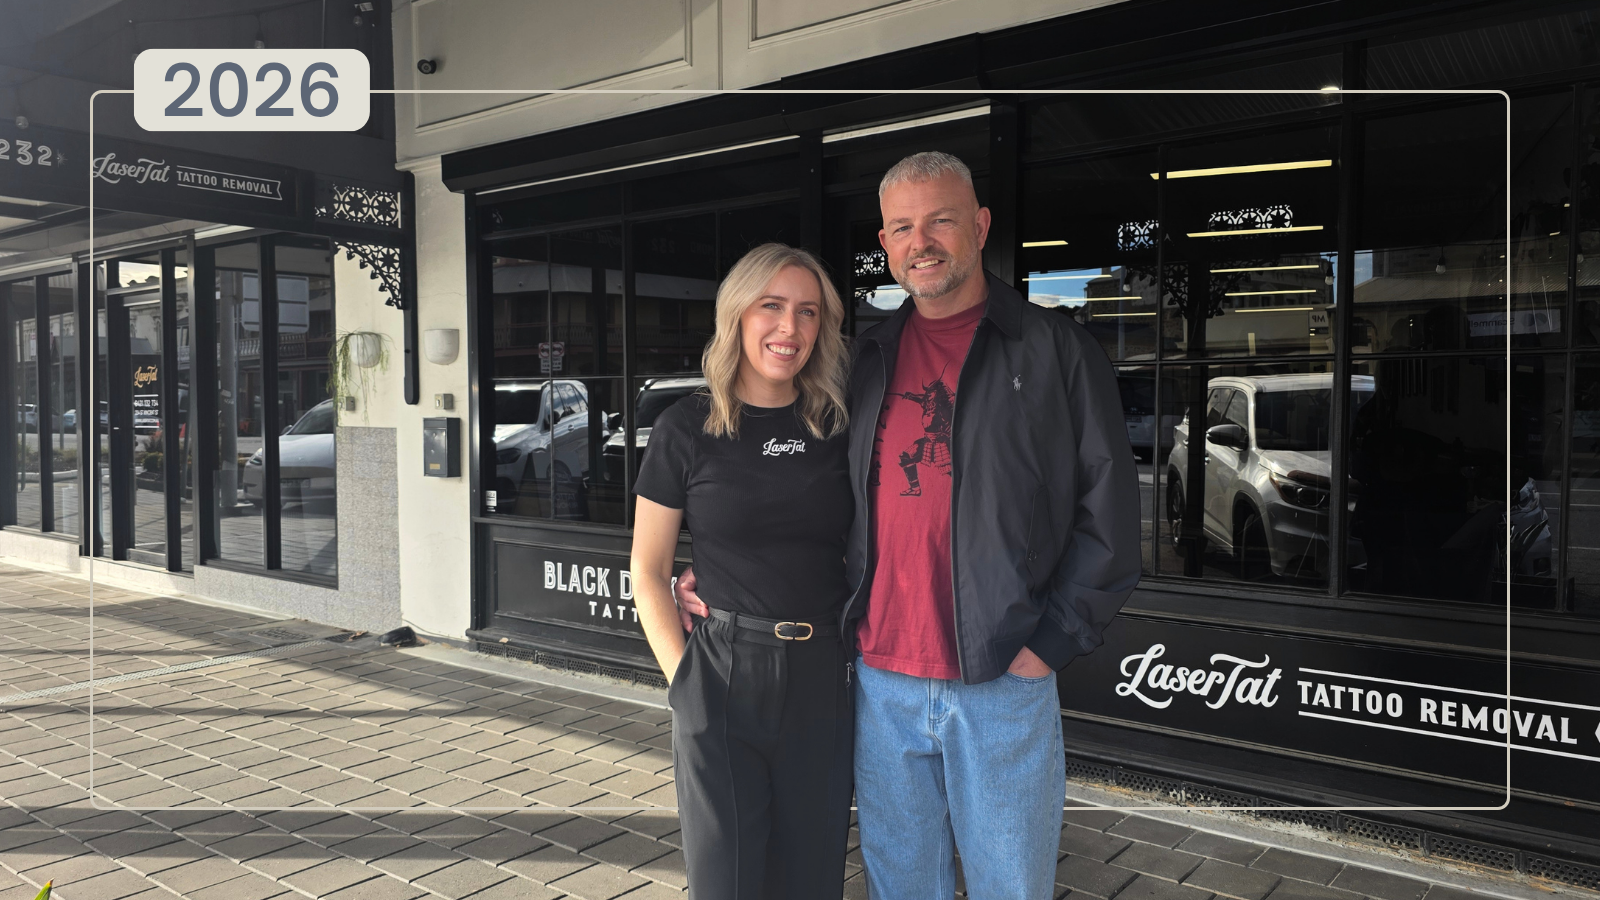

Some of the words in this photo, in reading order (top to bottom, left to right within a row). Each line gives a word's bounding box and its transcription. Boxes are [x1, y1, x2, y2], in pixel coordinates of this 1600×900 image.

[0, 138, 53, 167] 232
[93, 153, 170, 184] LaserTat
[176, 171, 218, 186] TATTOO
[222, 178, 273, 195] REMOVAL
[762, 437, 806, 456] LaserTat
[544, 560, 611, 598] BLACK
[588, 601, 639, 623] TATT
[1115, 643, 1282, 710] LaserTat
[1297, 680, 1404, 718] TATTOO
[1420, 697, 1578, 744] REMOVAL
